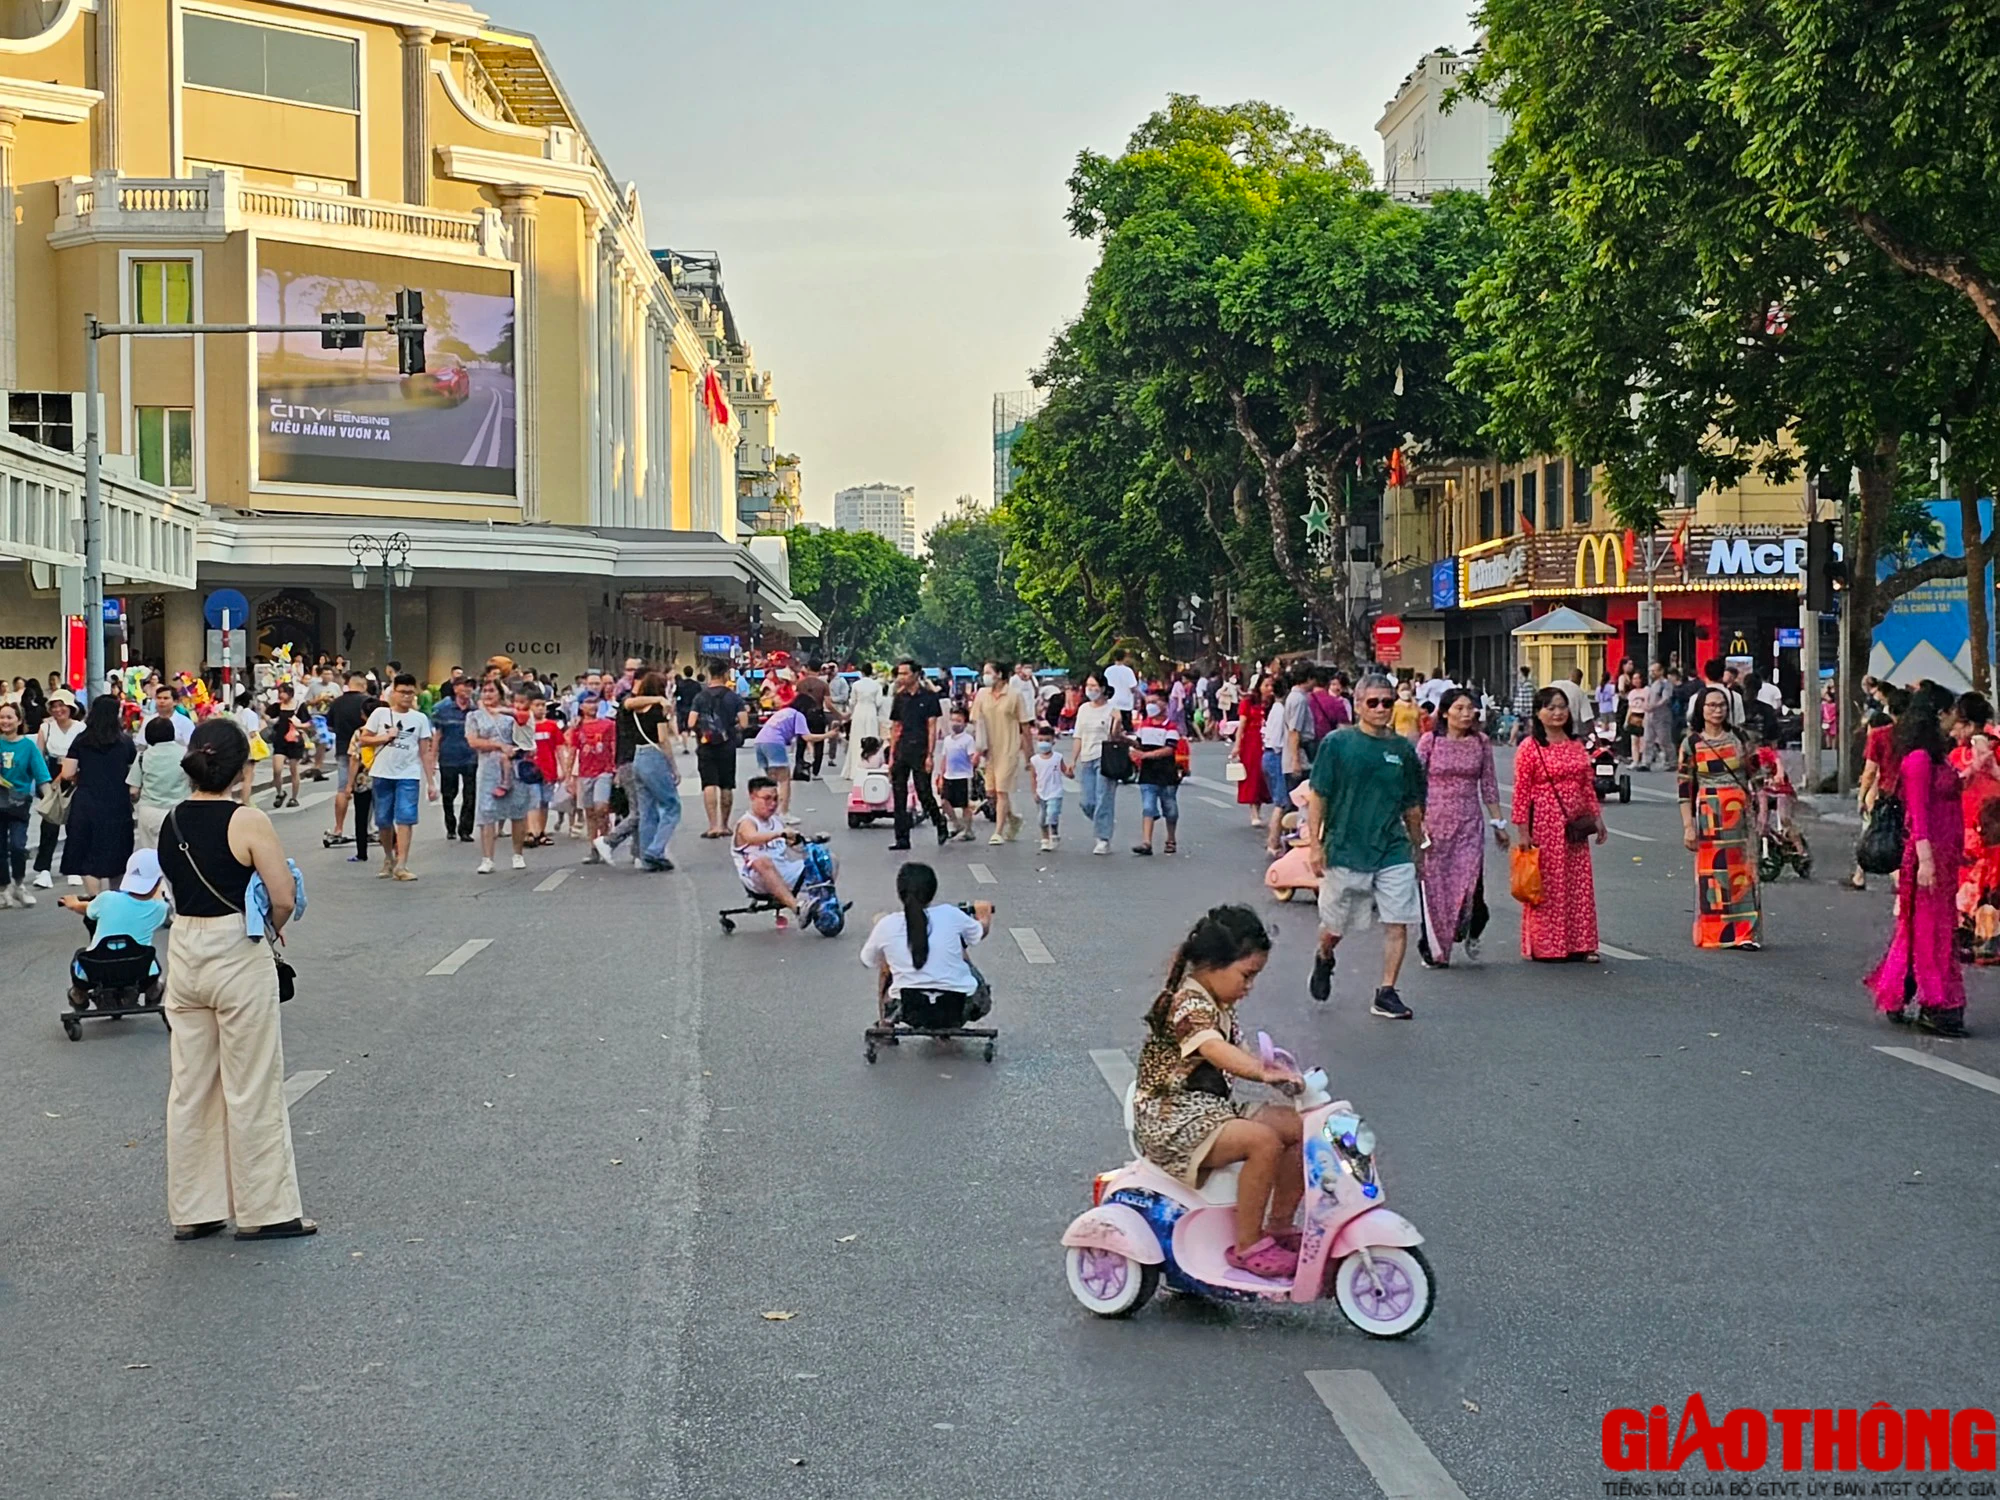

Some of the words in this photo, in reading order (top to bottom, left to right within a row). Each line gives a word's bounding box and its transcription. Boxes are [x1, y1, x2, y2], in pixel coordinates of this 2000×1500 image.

[270, 404, 328, 420] CITY
[333, 413, 390, 426] SENSING
[270, 420, 300, 434] KIÊU
[375, 429, 391, 441] XA
[505, 642, 560, 654] GUCCI
